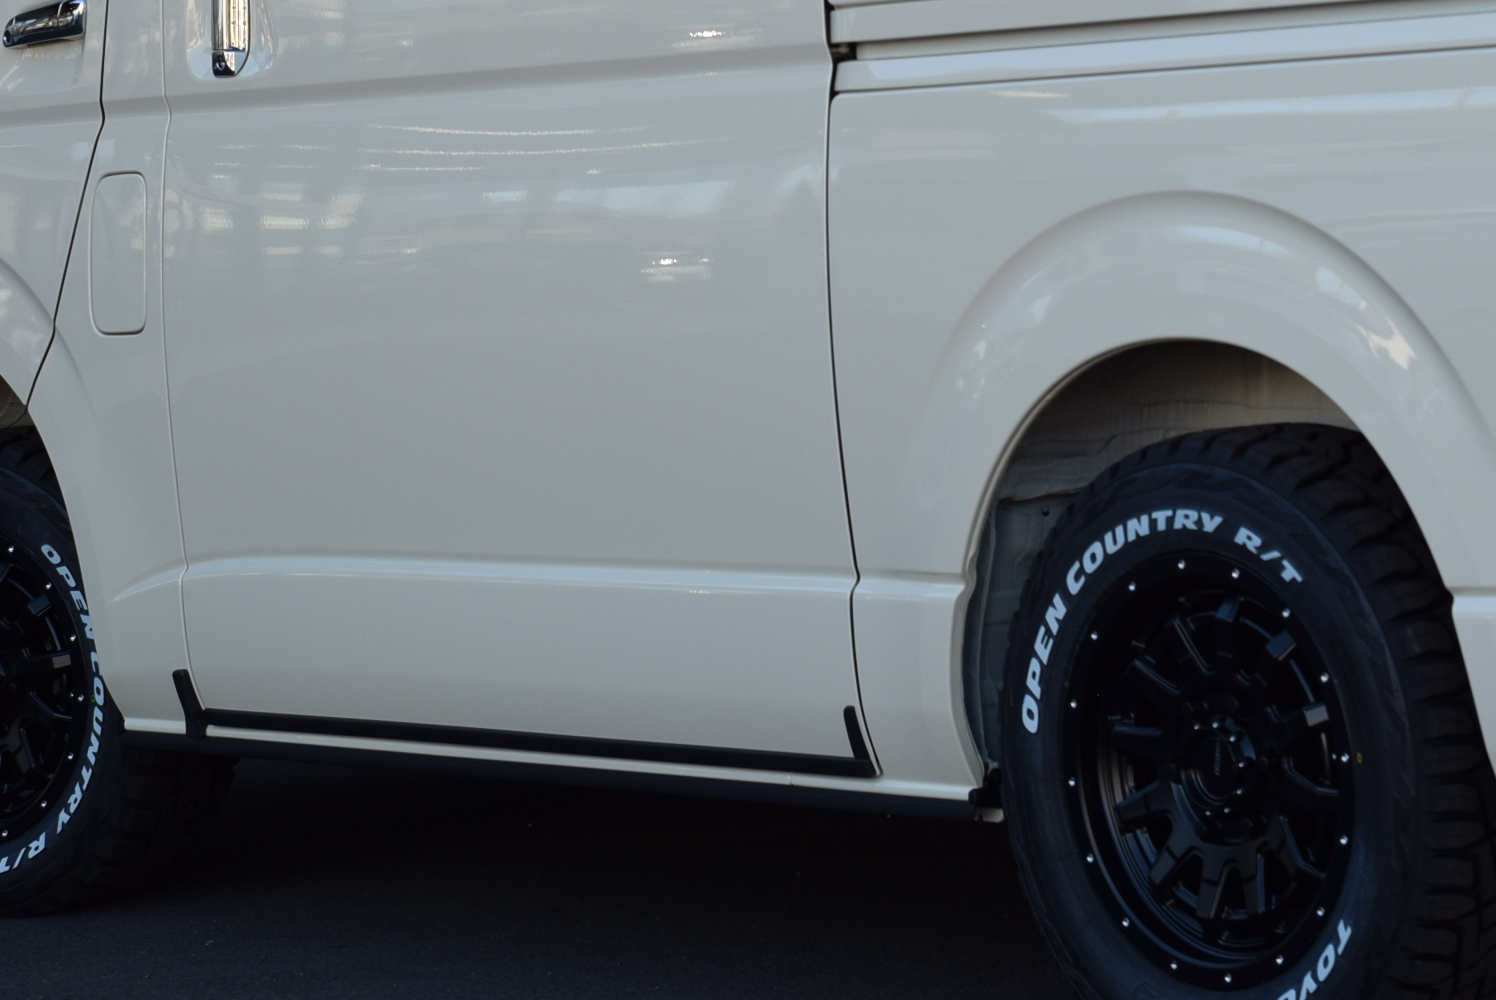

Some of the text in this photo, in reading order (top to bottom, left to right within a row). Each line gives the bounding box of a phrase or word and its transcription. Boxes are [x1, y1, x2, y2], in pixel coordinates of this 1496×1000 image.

[40, 543, 95, 640] OPEN
[1021, 508, 1303, 735] OPEN COUNTRY R/T
